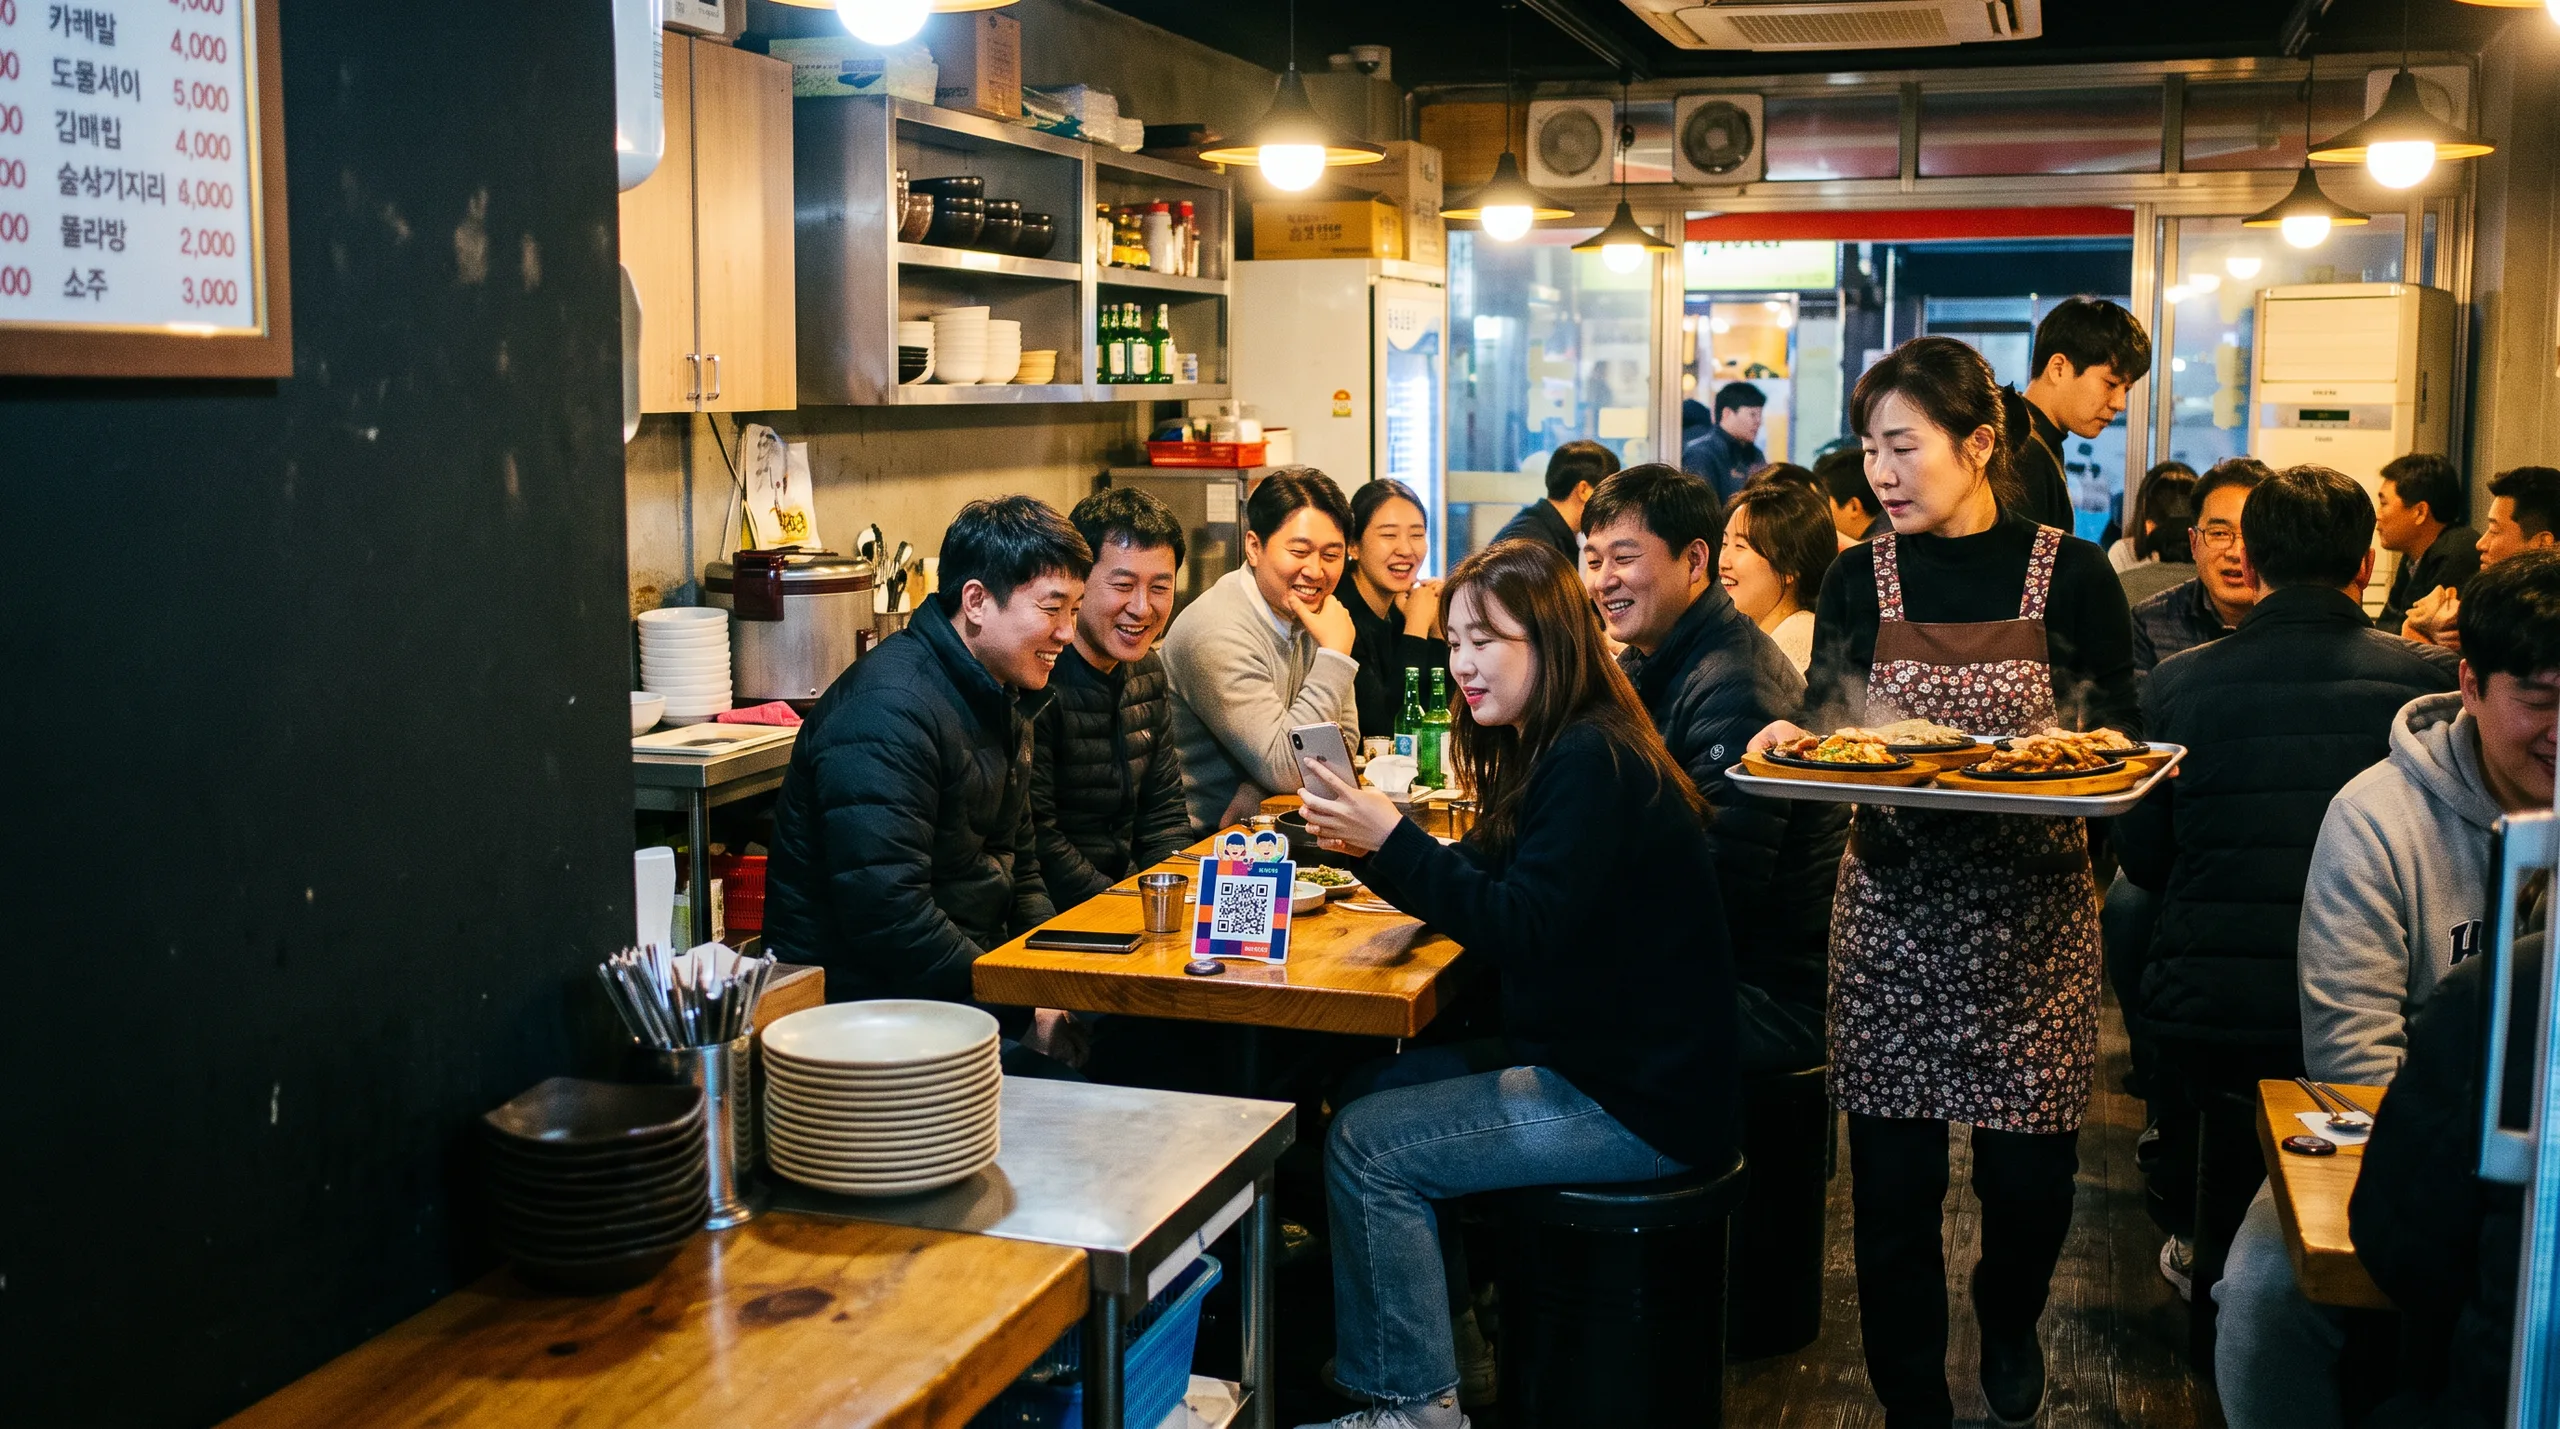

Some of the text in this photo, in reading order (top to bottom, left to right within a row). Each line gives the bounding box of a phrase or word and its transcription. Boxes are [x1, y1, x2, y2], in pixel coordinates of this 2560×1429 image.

[170, 29, 227, 64] 4,000
[173, 79, 229, 113] 5,000
[175, 129, 231, 162] 4,000
[180, 227, 235, 259] 2,000
[63, 267, 237, 308] 소주 3,000
